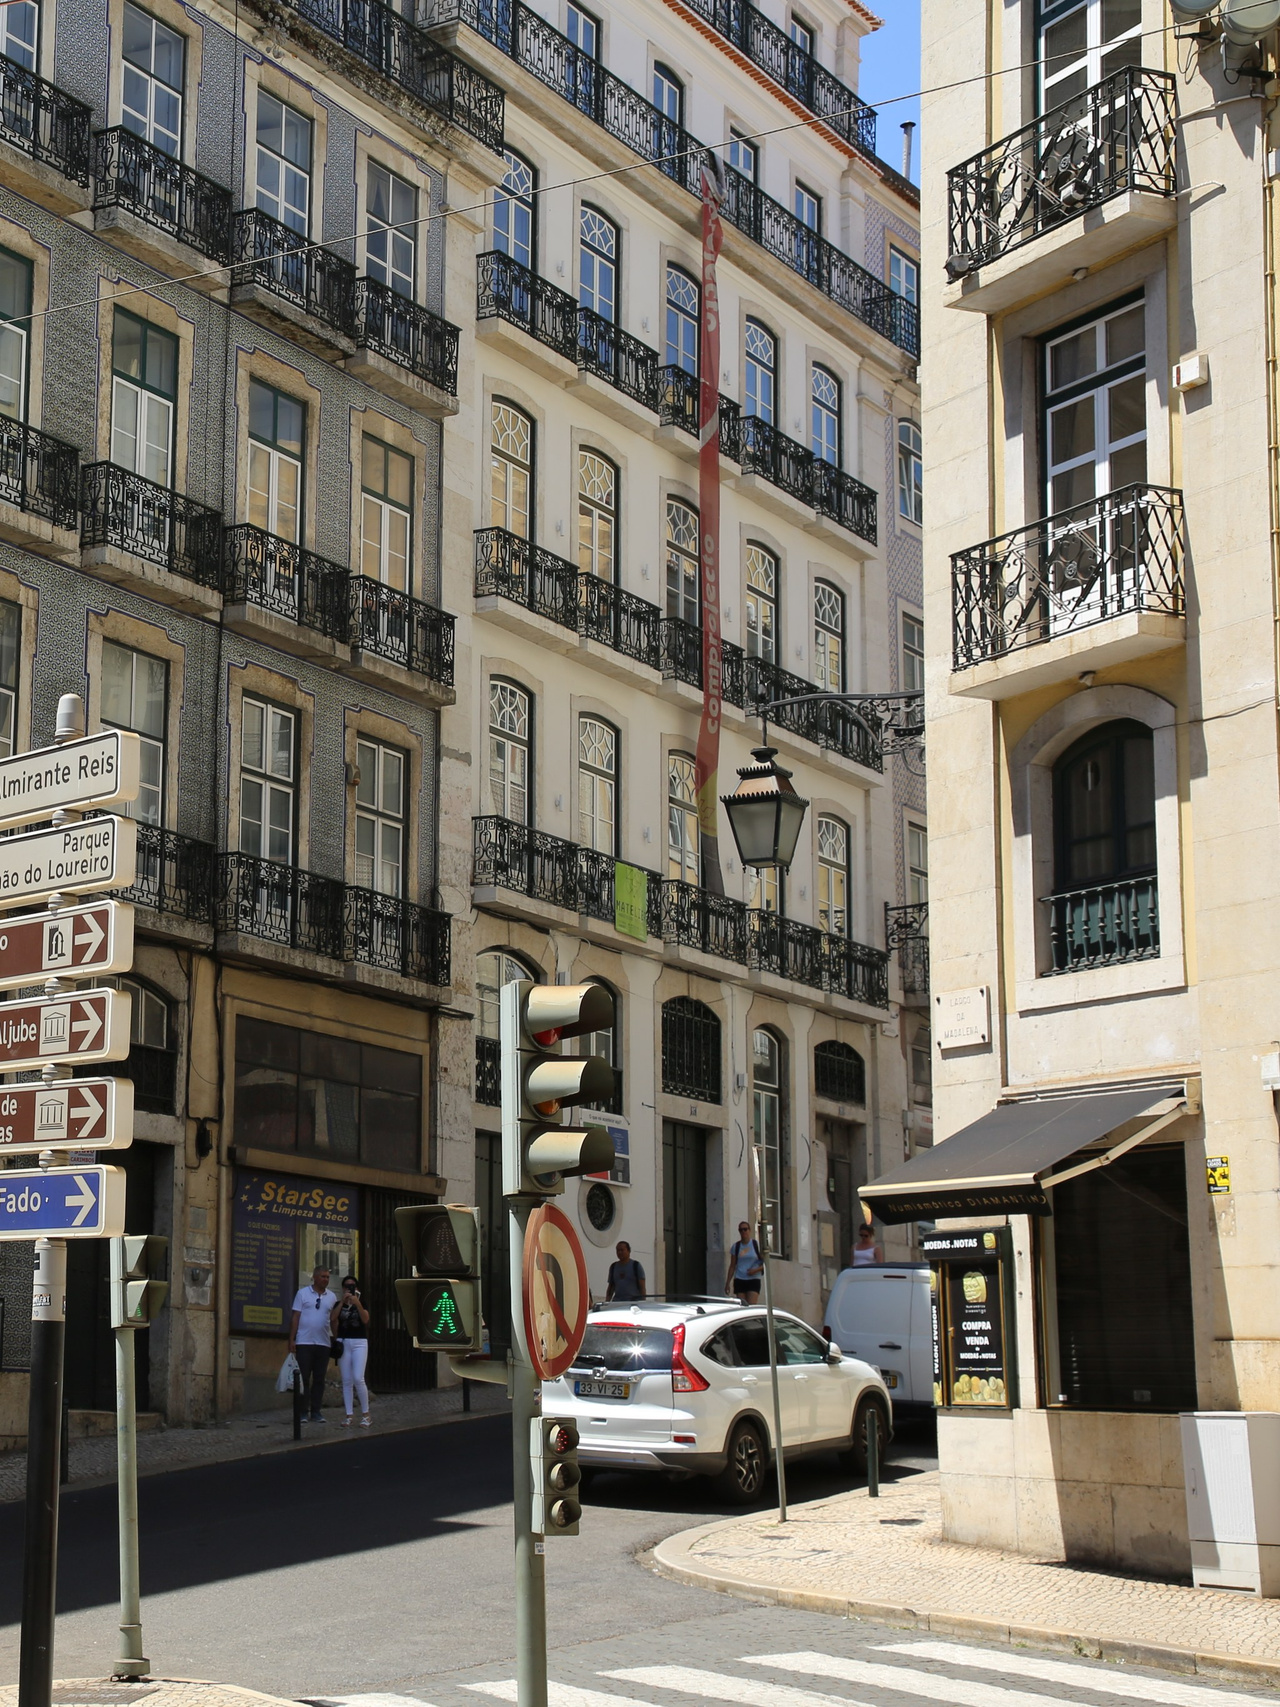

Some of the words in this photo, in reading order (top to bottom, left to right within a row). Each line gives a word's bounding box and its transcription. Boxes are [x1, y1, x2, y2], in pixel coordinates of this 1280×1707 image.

[78, 751, 114, 780] Reis
[62, 830, 110, 857] Parque
[24, 863, 42, 884] do
[48, 854, 109, 880] Loureiro
[1, 1095, 18, 1116] de
[261, 1181, 349, 1212] StarSec
[272, 1204, 314, 1218] Limpeza
[316, 1211, 323, 1219] a
[325, 1211, 349, 1222] Seco
[962, 1321, 992, 1331] COMPRA
[965, 1336, 990, 1346] VENDA
